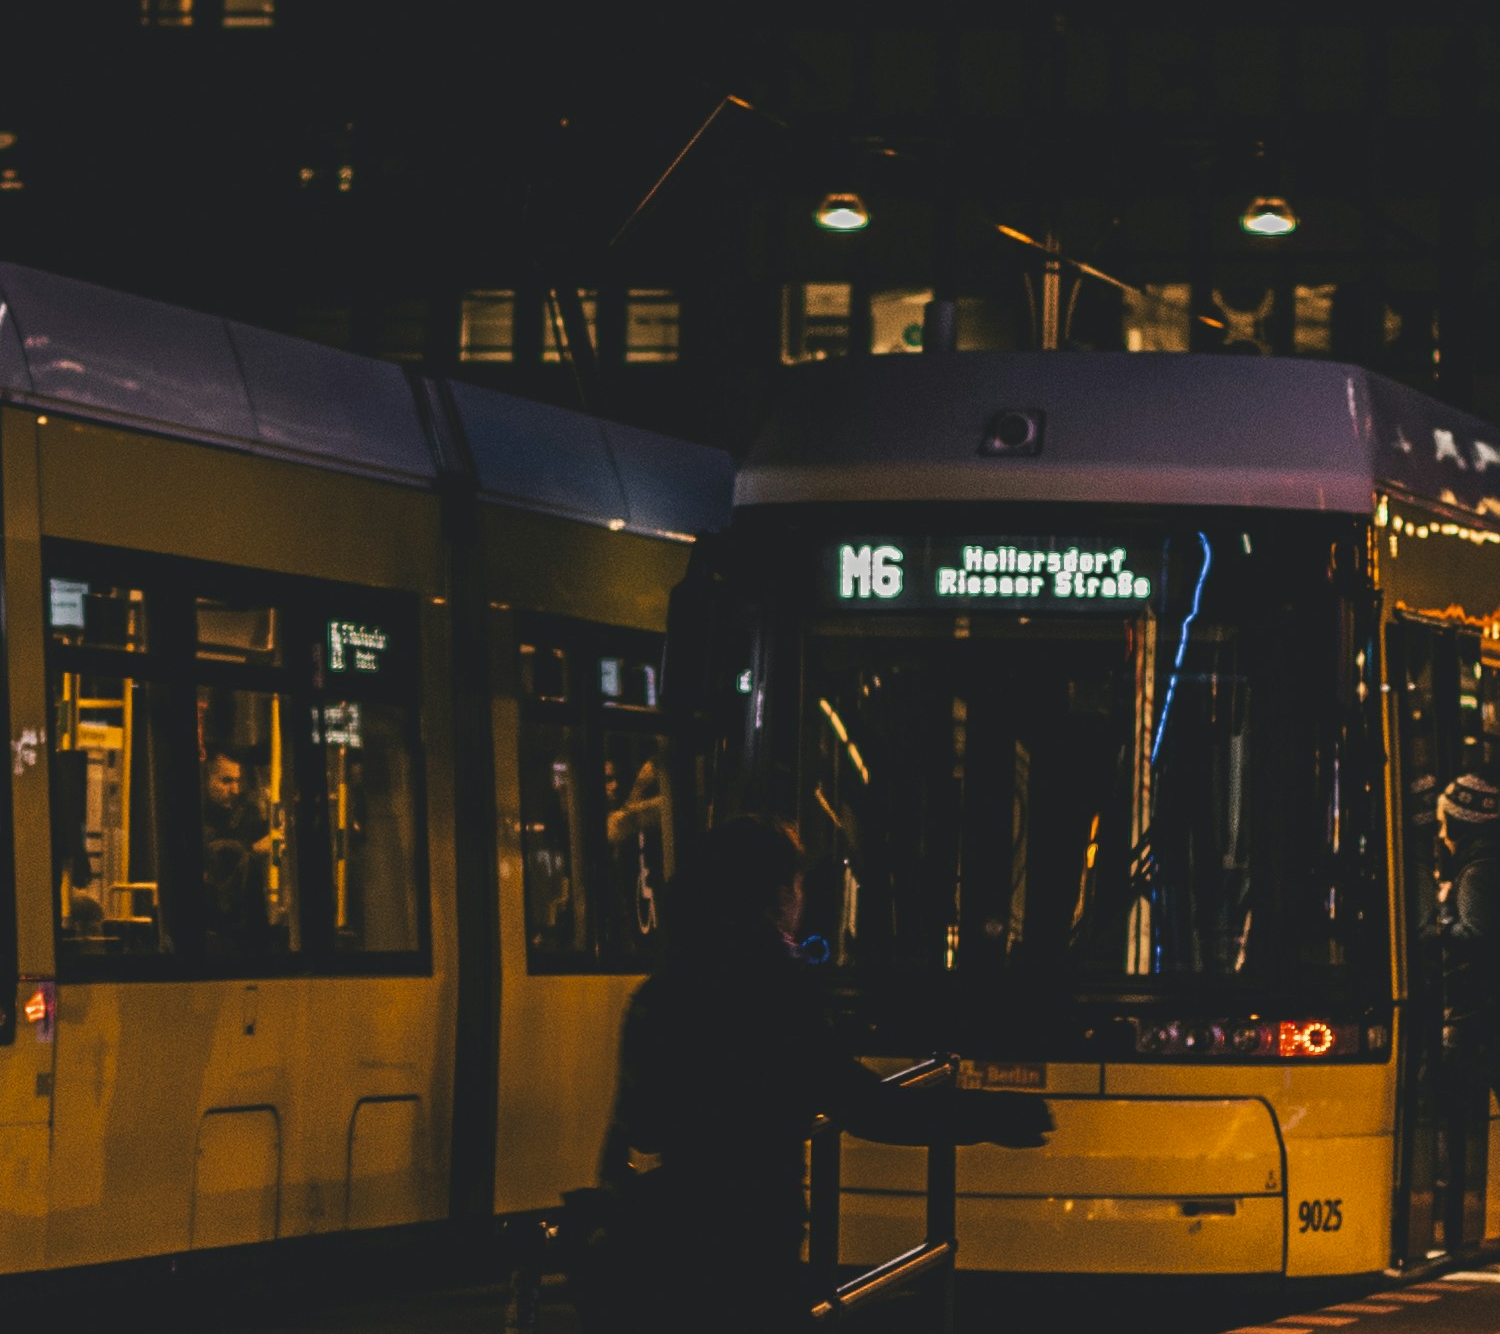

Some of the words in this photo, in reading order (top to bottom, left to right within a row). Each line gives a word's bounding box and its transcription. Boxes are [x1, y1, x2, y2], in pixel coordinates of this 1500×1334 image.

[840, 545, 904, 599] M6
[962, 546, 1128, 574] Hellersdorf
[1054, 571, 1151, 598] Straße
[1298, 1199, 1343, 1233] 9025
